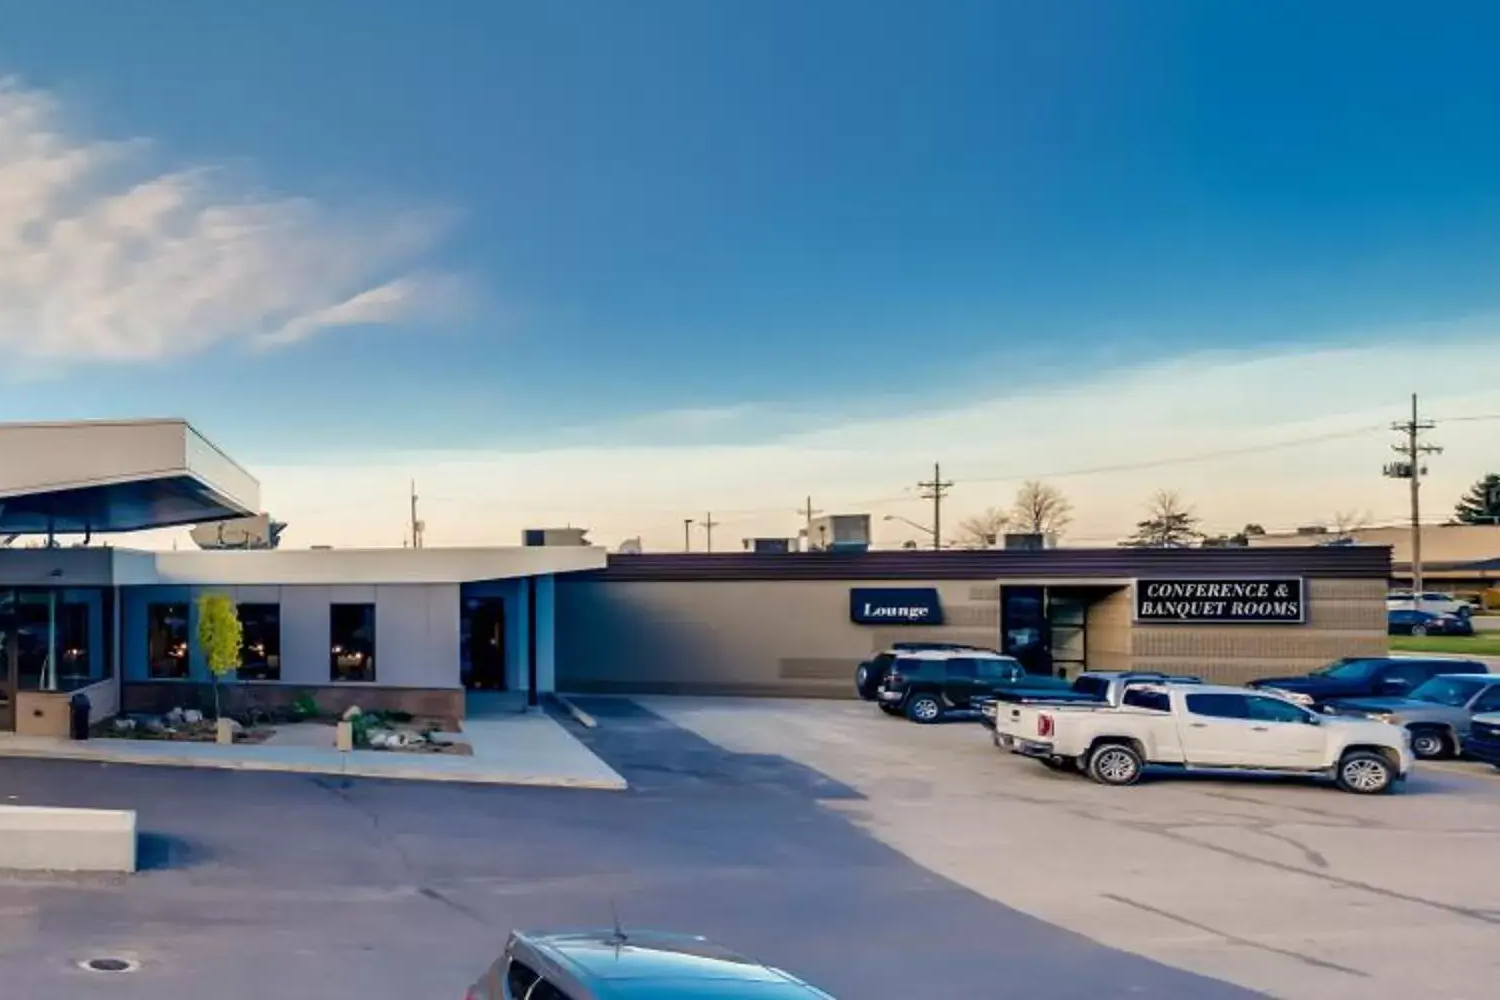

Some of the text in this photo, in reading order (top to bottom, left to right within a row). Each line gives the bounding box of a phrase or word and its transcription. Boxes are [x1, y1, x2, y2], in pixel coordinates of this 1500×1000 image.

[1147, 583, 1289, 598] CONFERENCE &
[863, 602, 929, 621] Lounge
[1141, 601, 1298, 619] BANQUET ROOMS
